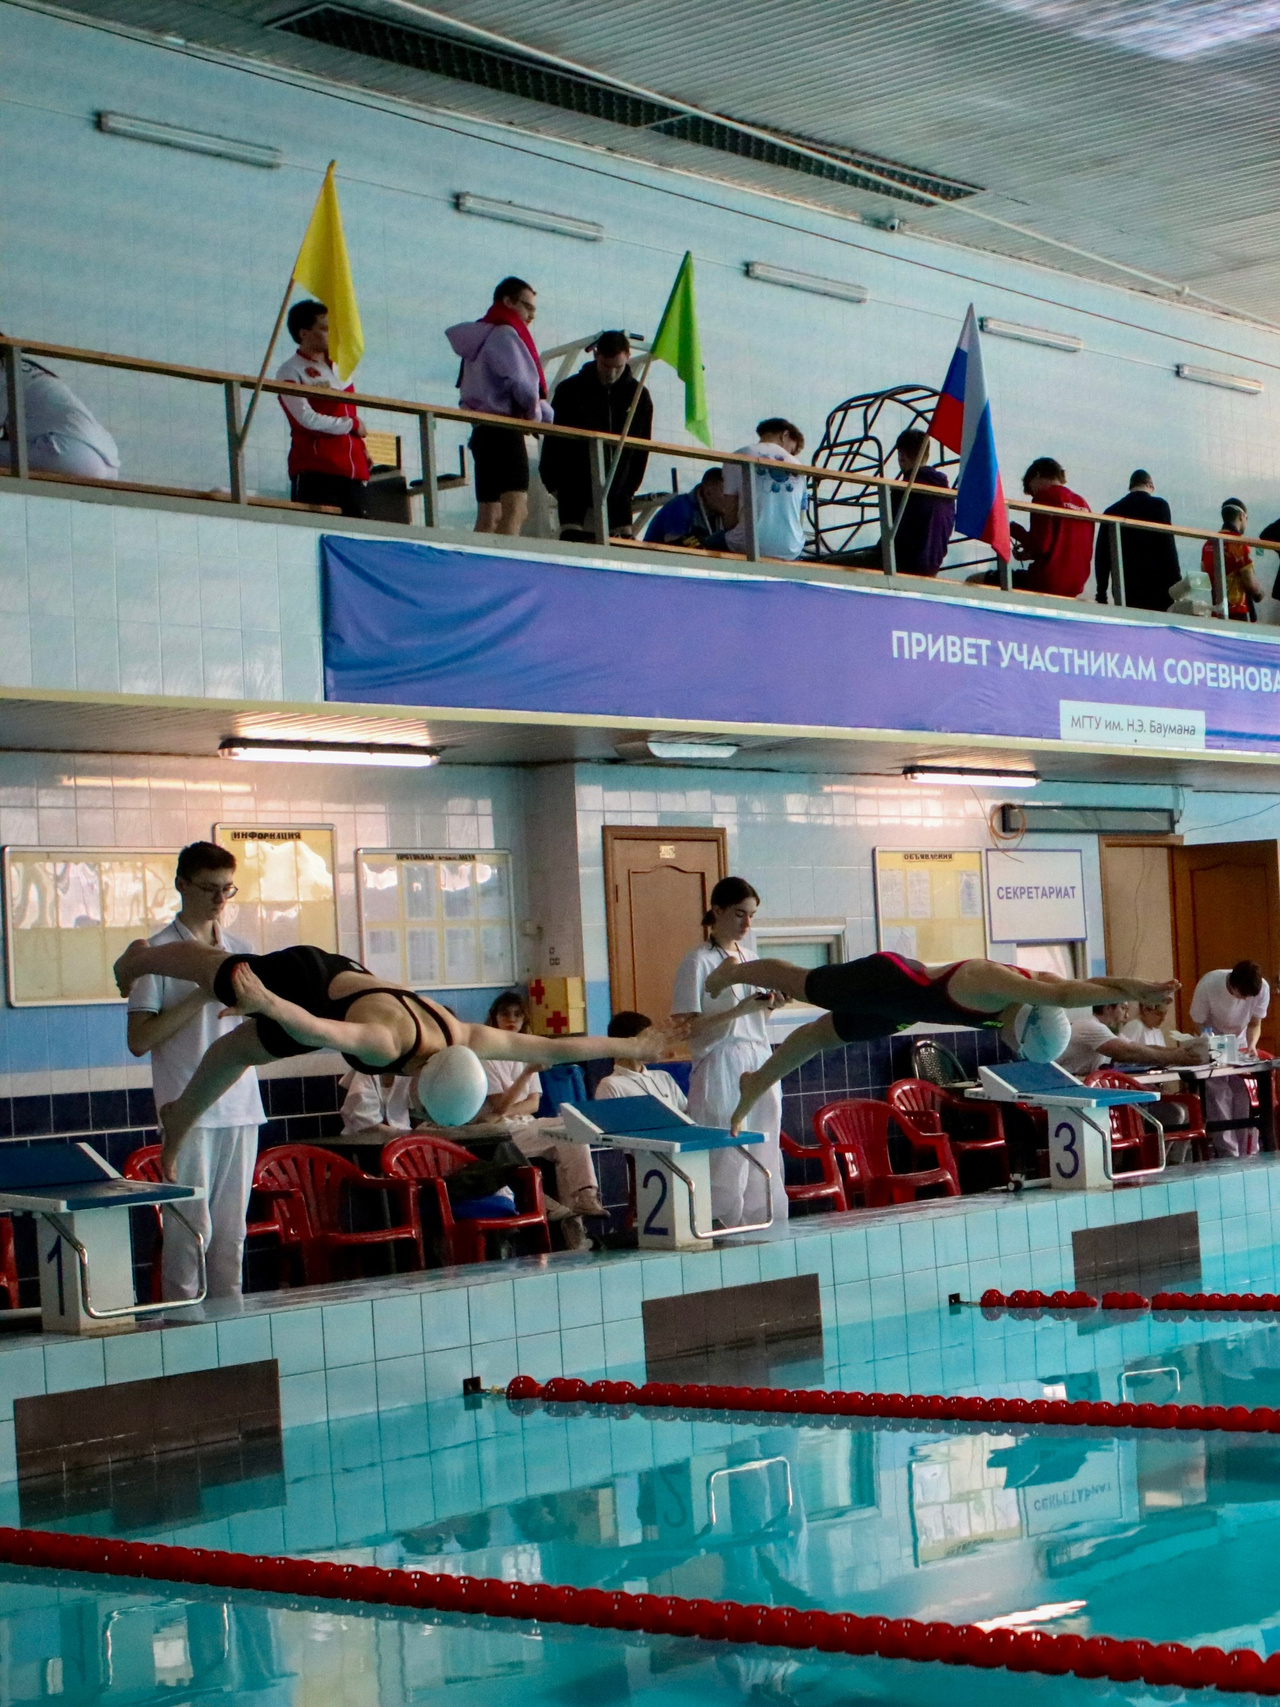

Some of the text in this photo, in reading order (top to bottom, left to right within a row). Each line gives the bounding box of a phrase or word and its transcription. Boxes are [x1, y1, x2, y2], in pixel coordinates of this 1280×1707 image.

[892, 630, 991, 666] ПРИВЕТ
[998, 640, 1157, 682] УЧАСТНИКАМ
[1070, 715, 1197, 738] МГТУ им. Н.Э. Баумана
[996, 886, 1076, 900] СЕКРЕТАРИАТ
[1054, 1121, 1079, 1179] 3
[642, 1168, 669, 1236] 2
[46, 1234, 65, 1316] 1
